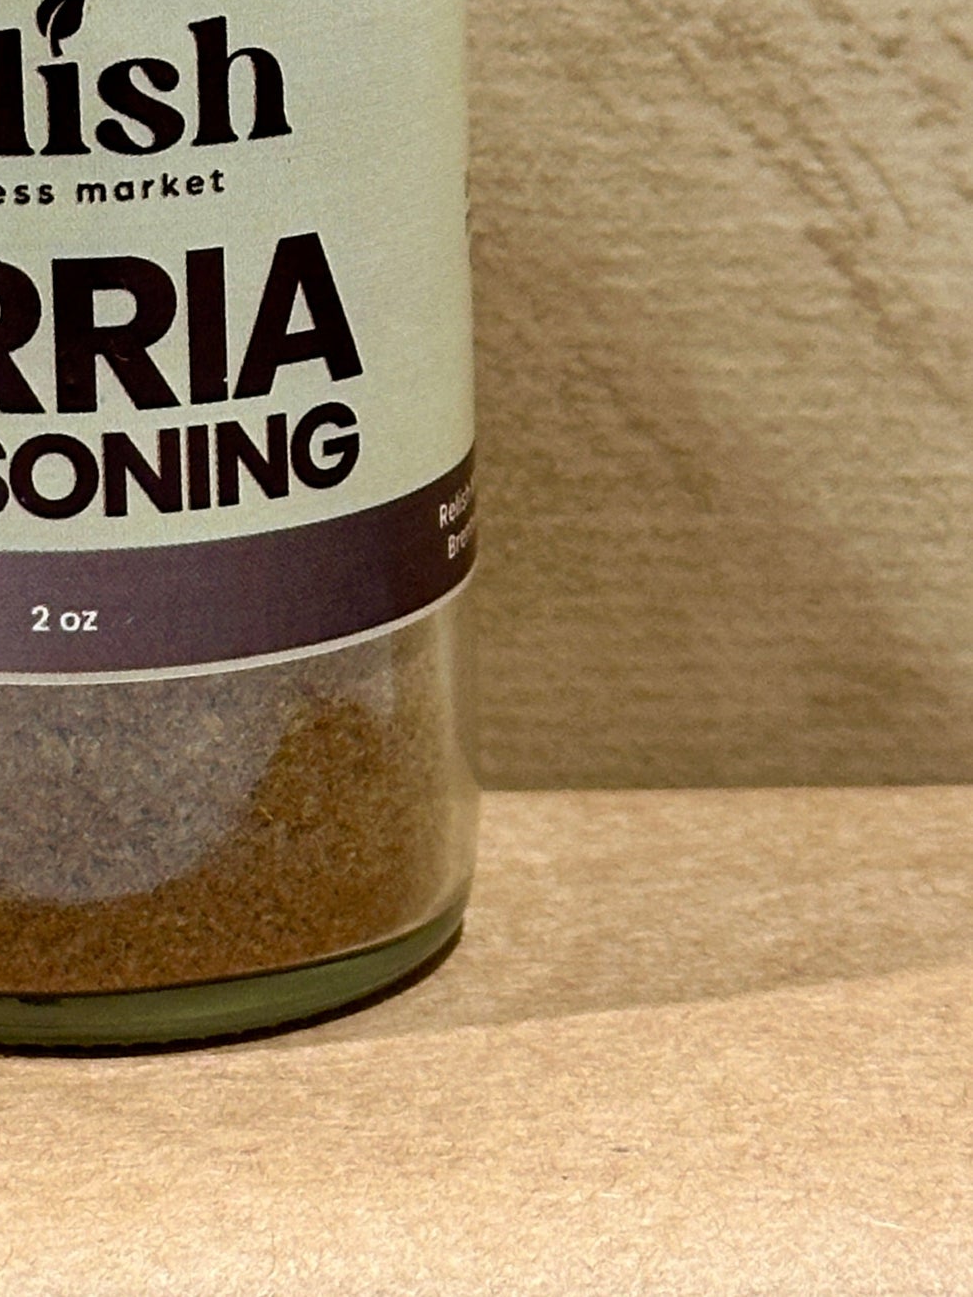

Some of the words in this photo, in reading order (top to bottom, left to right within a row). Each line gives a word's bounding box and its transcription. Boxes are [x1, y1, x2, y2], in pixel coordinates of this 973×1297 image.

[75, 169, 225, 205] market
[31, 605, 50, 632] 2
[59, 611, 98, 632] oz
